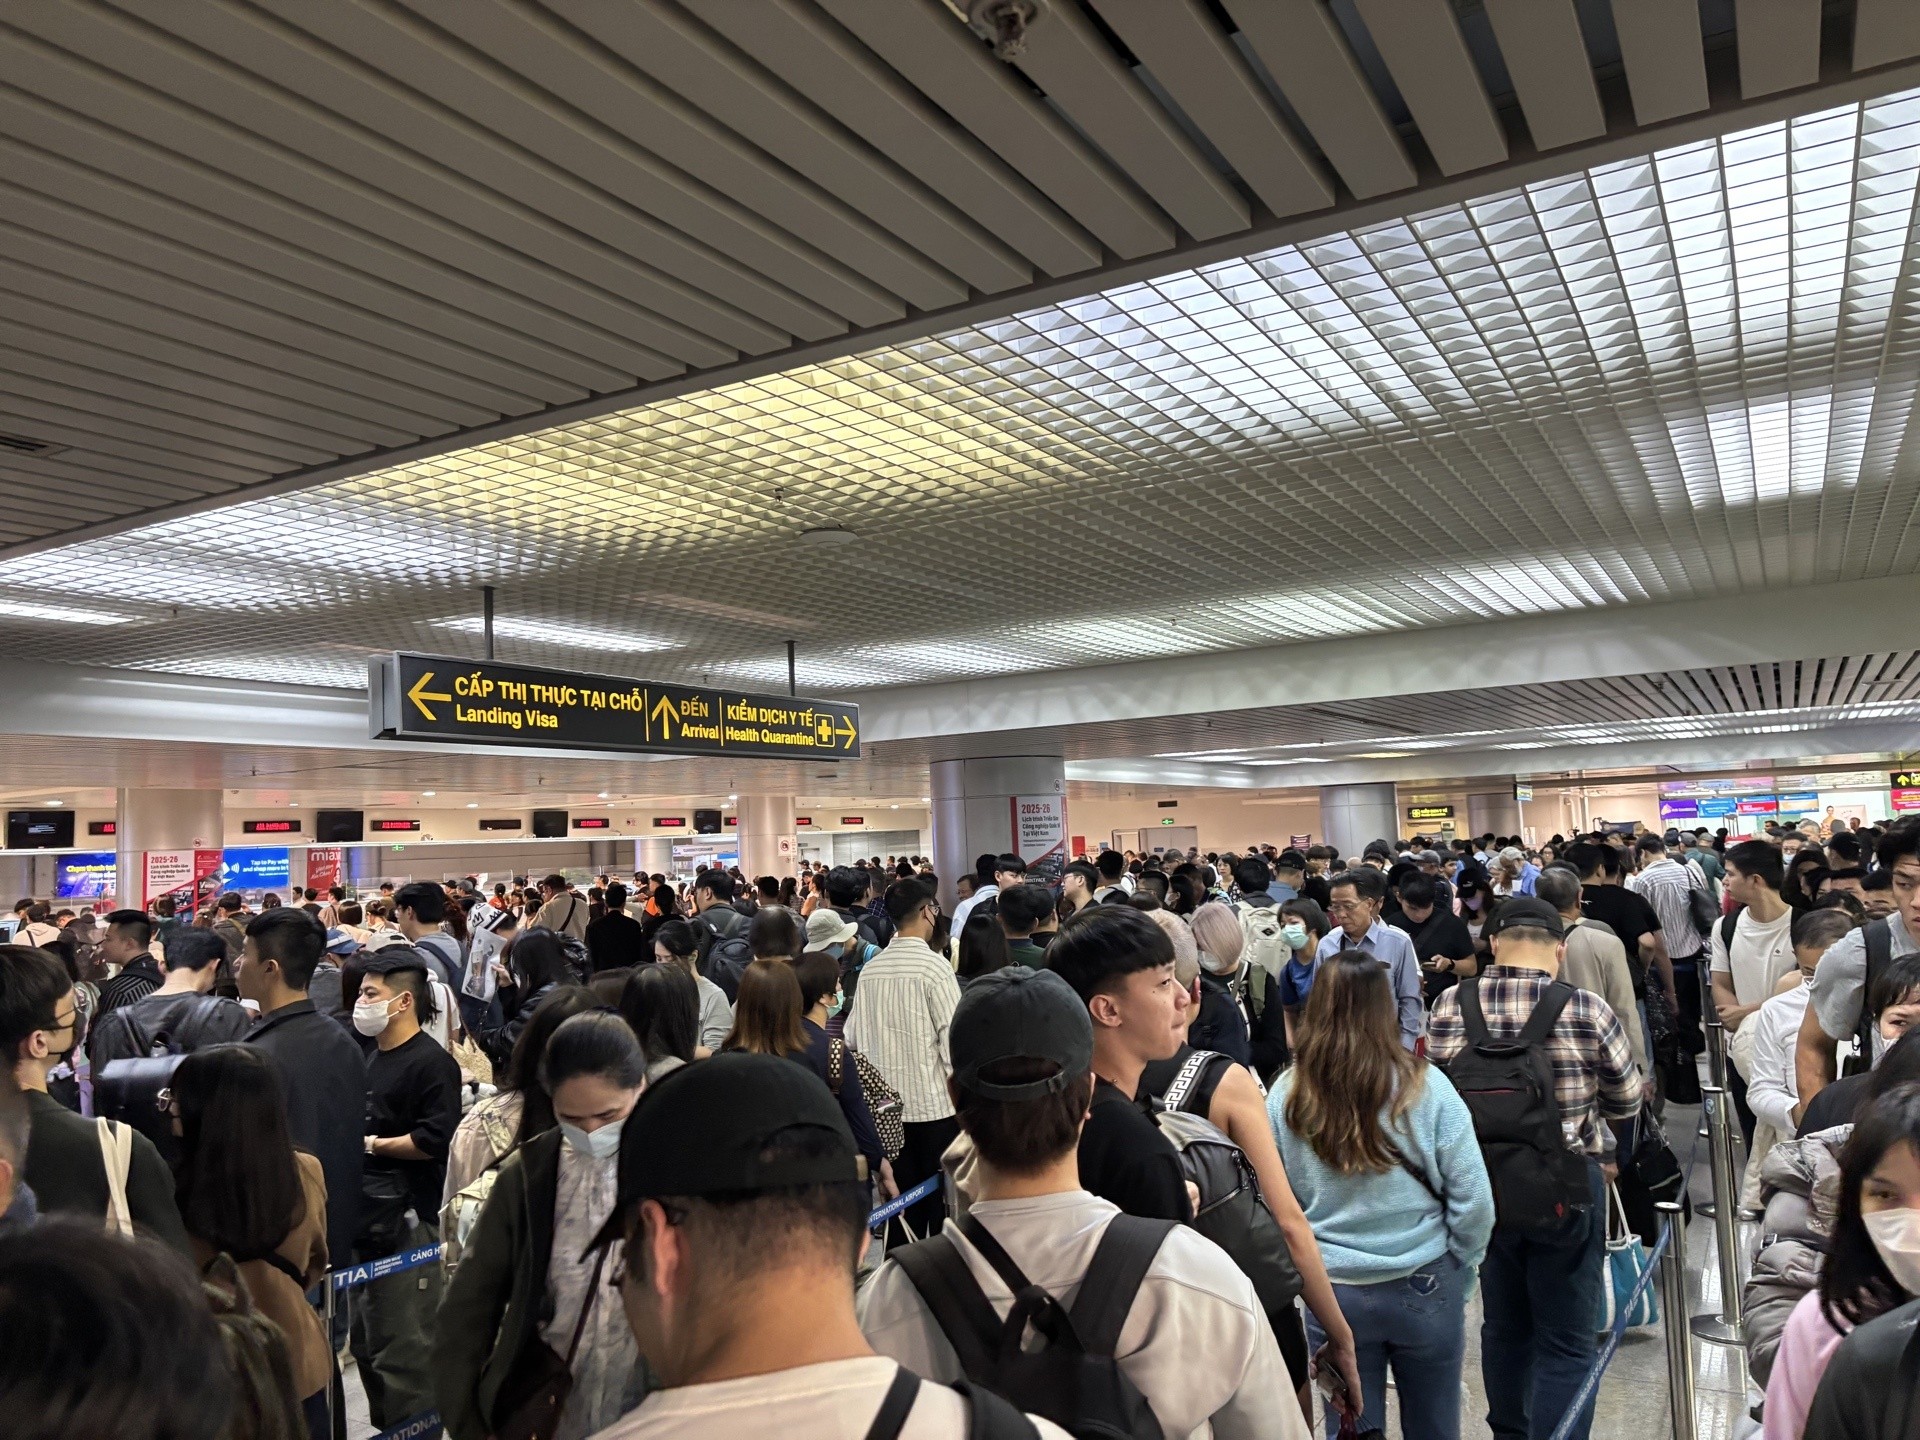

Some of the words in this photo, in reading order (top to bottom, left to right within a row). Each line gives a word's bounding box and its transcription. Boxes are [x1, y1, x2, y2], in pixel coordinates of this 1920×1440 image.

[455, 671, 494, 698] CẤP
[498, 681, 527, 705] THỊ
[530, 684, 577, 708] THỰC
[580, 689, 606, 711] TẠI
[609, 687, 642, 712] CHỖ
[456, 703, 522, 729] Landing
[525, 709, 558, 728] Visa
[681, 695, 709, 718] ĐẾN
[727, 698, 757, 722] KIỂM
[760, 708, 787, 726] DỊCH
[789, 711, 798, 725] Y
[799, 708, 813, 727] TẾ
[682, 722, 719, 739] Arrival
[726, 726, 759, 742] Health
[761, 731, 814, 746] Quarantine
[1021, 803, 1051, 814] 2025-26
[150, 855, 178, 864] 2025-26
[904, 1186, 925, 1204] AIRPORT
[410, 1249, 433, 1263] CẢNG
[334, 1267, 368, 1287] TIA
